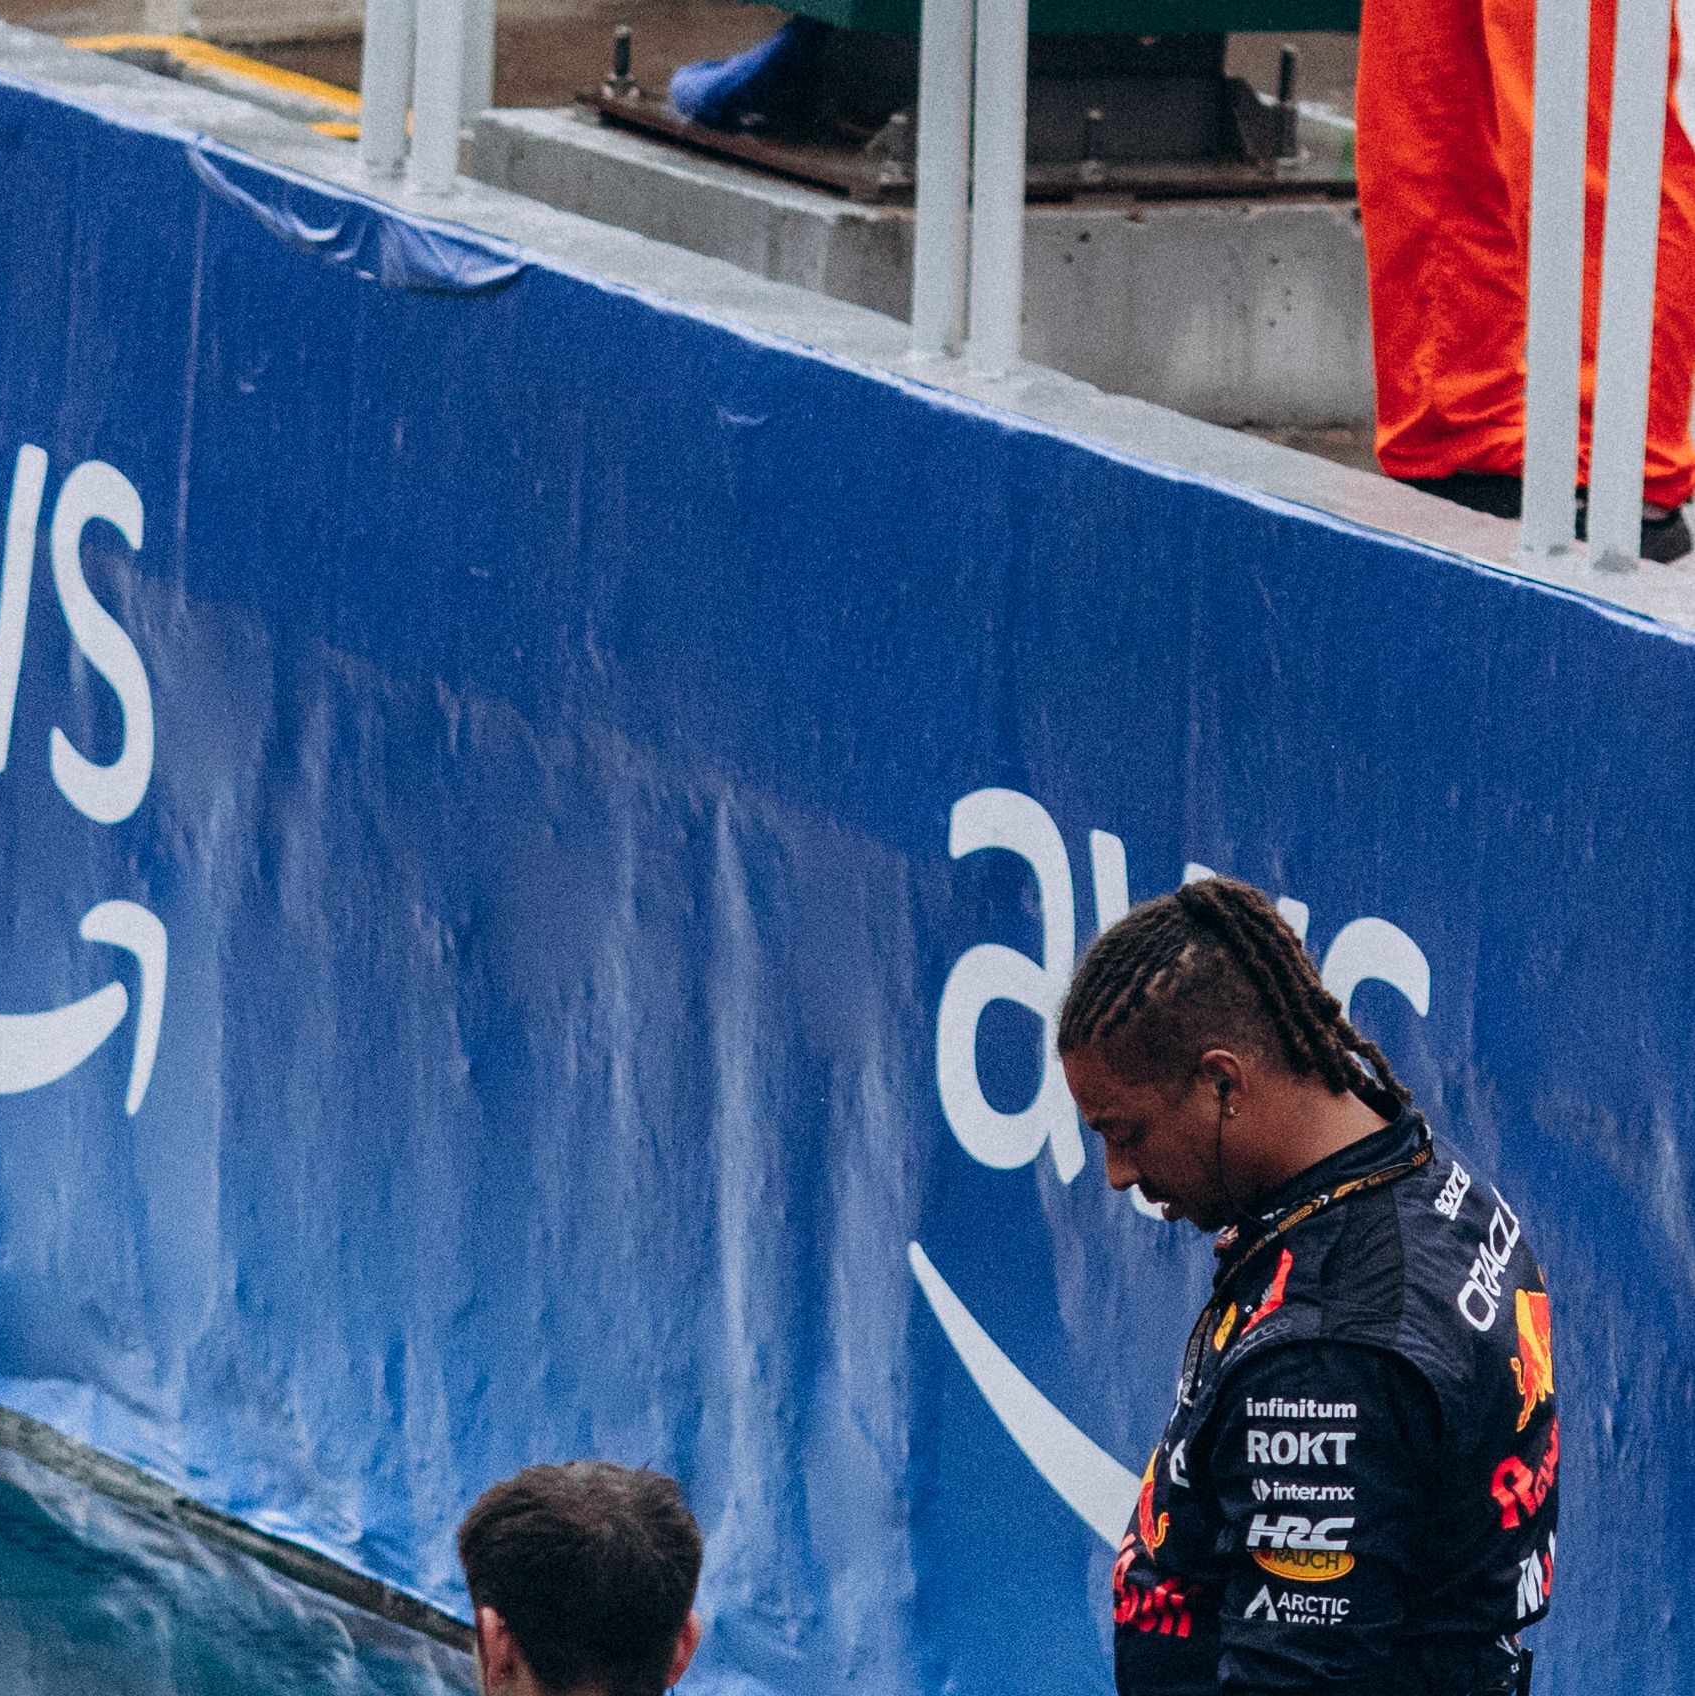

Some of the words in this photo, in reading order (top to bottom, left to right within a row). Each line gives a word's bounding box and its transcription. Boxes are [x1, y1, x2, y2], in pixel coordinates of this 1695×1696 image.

[1246, 1397, 1357, 1419] infinitum
[1246, 1431, 1357, 1466] ROKT
[1272, 1481, 1356, 1501] inter.mx
[1246, 1515, 1357, 1552] HRC
[1276, 1591, 1351, 1616] ARCTIC
